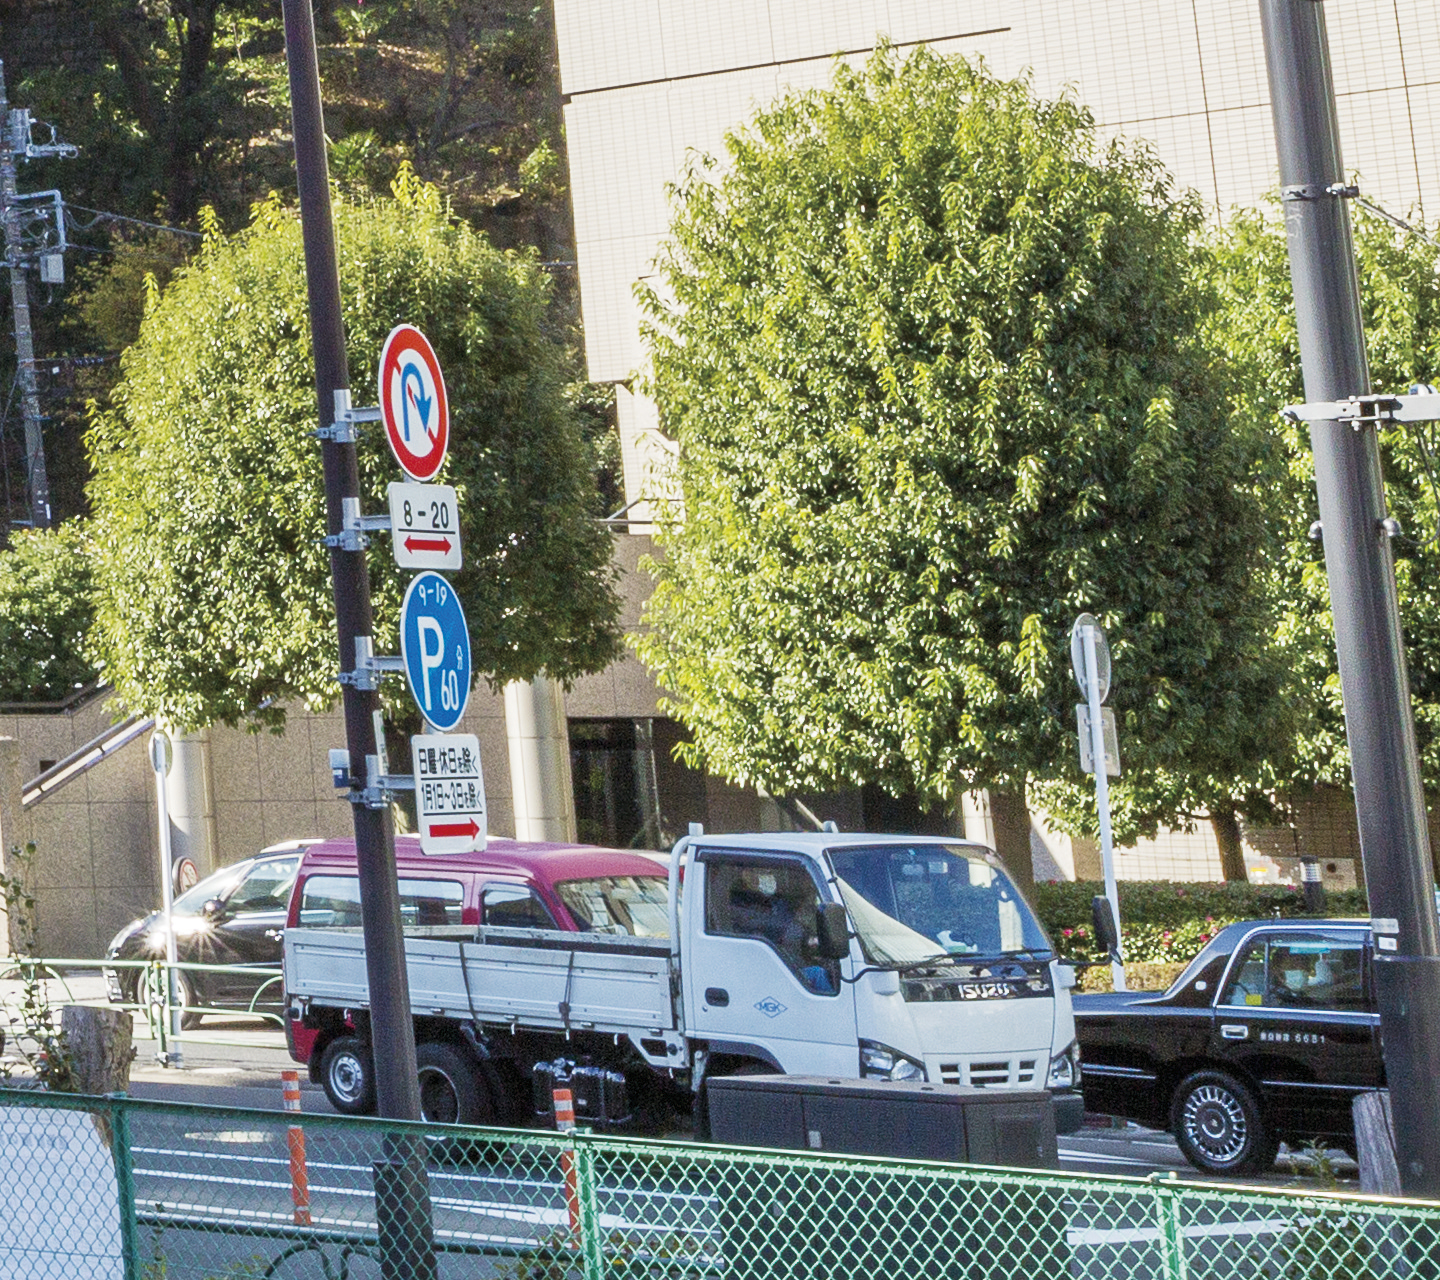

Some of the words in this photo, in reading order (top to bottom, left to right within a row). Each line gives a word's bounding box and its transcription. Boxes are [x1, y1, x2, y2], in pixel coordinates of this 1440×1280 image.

[403, 500, 449, 529] 8-20
[418, 581, 448, 607] 9-19
[417, 616, 445, 711] P
[441, 669, 459, 711] 60
[958, 983, 1010, 999] ISUZU
